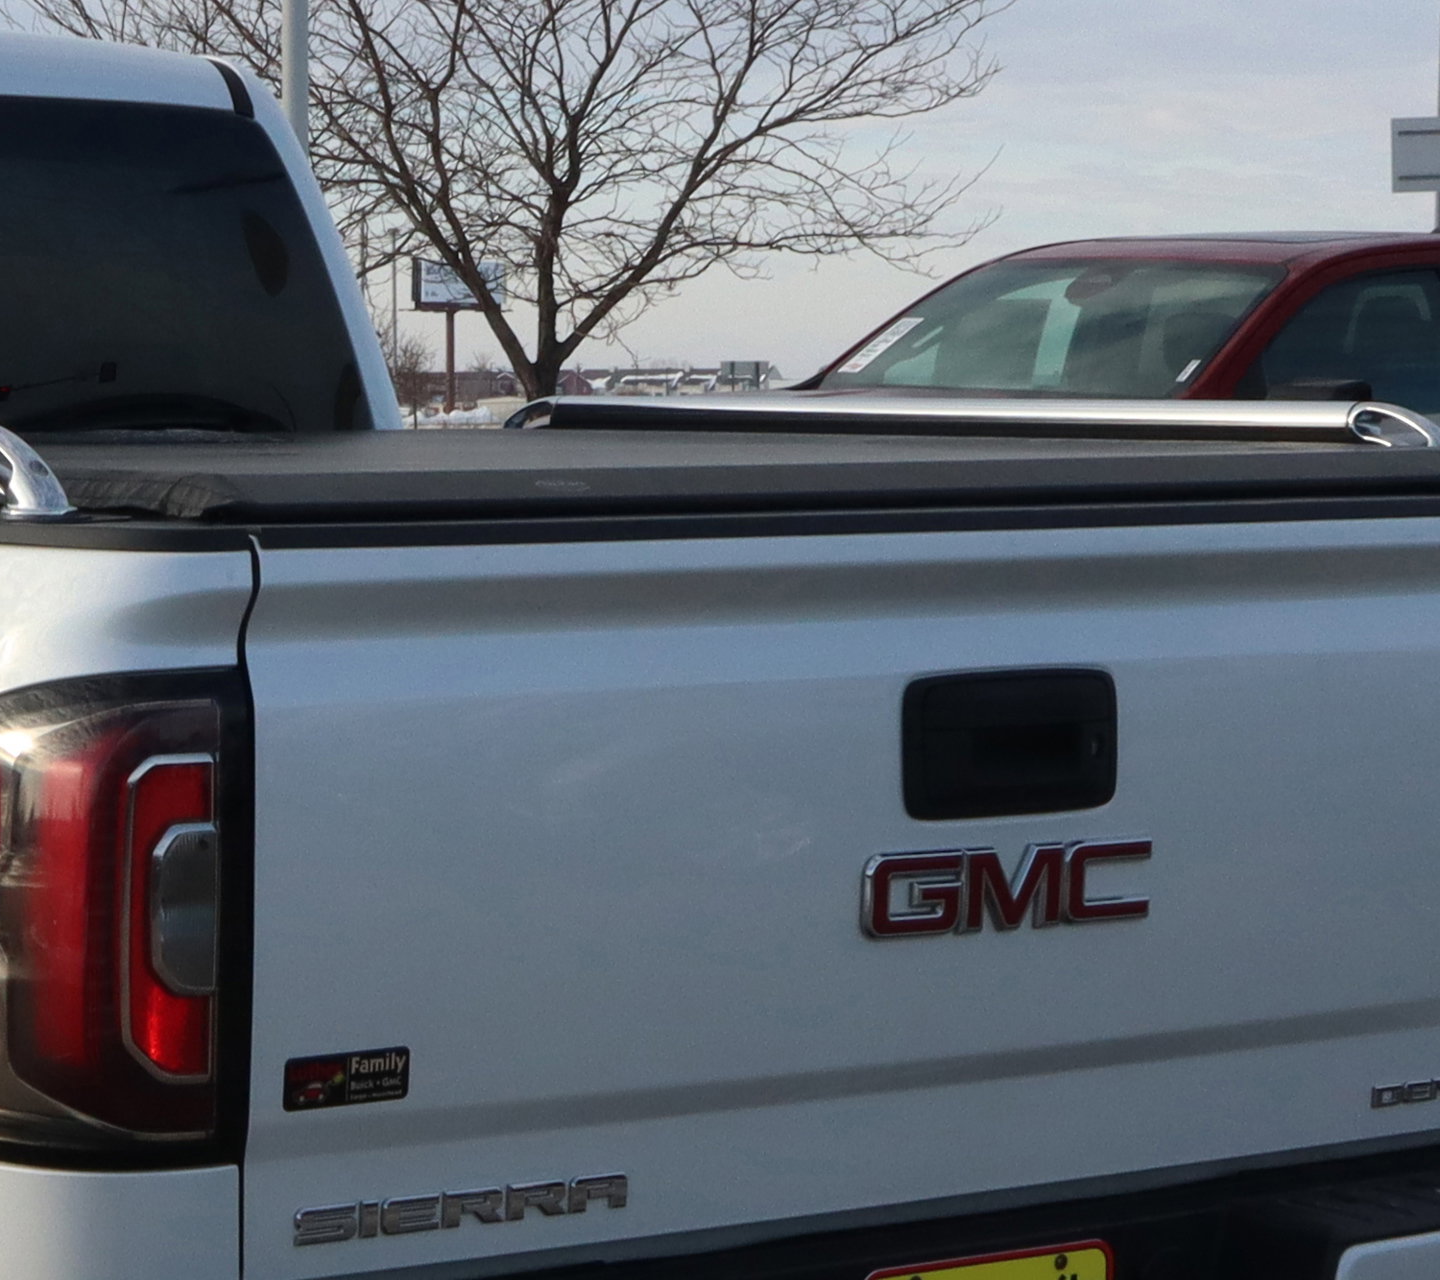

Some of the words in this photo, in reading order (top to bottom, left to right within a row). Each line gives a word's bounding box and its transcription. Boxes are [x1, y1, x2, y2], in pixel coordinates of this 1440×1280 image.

[859, 836, 1153, 940] GMC
[350, 1052, 406, 1075] Family
[293, 1171, 628, 1247] SIERRA
